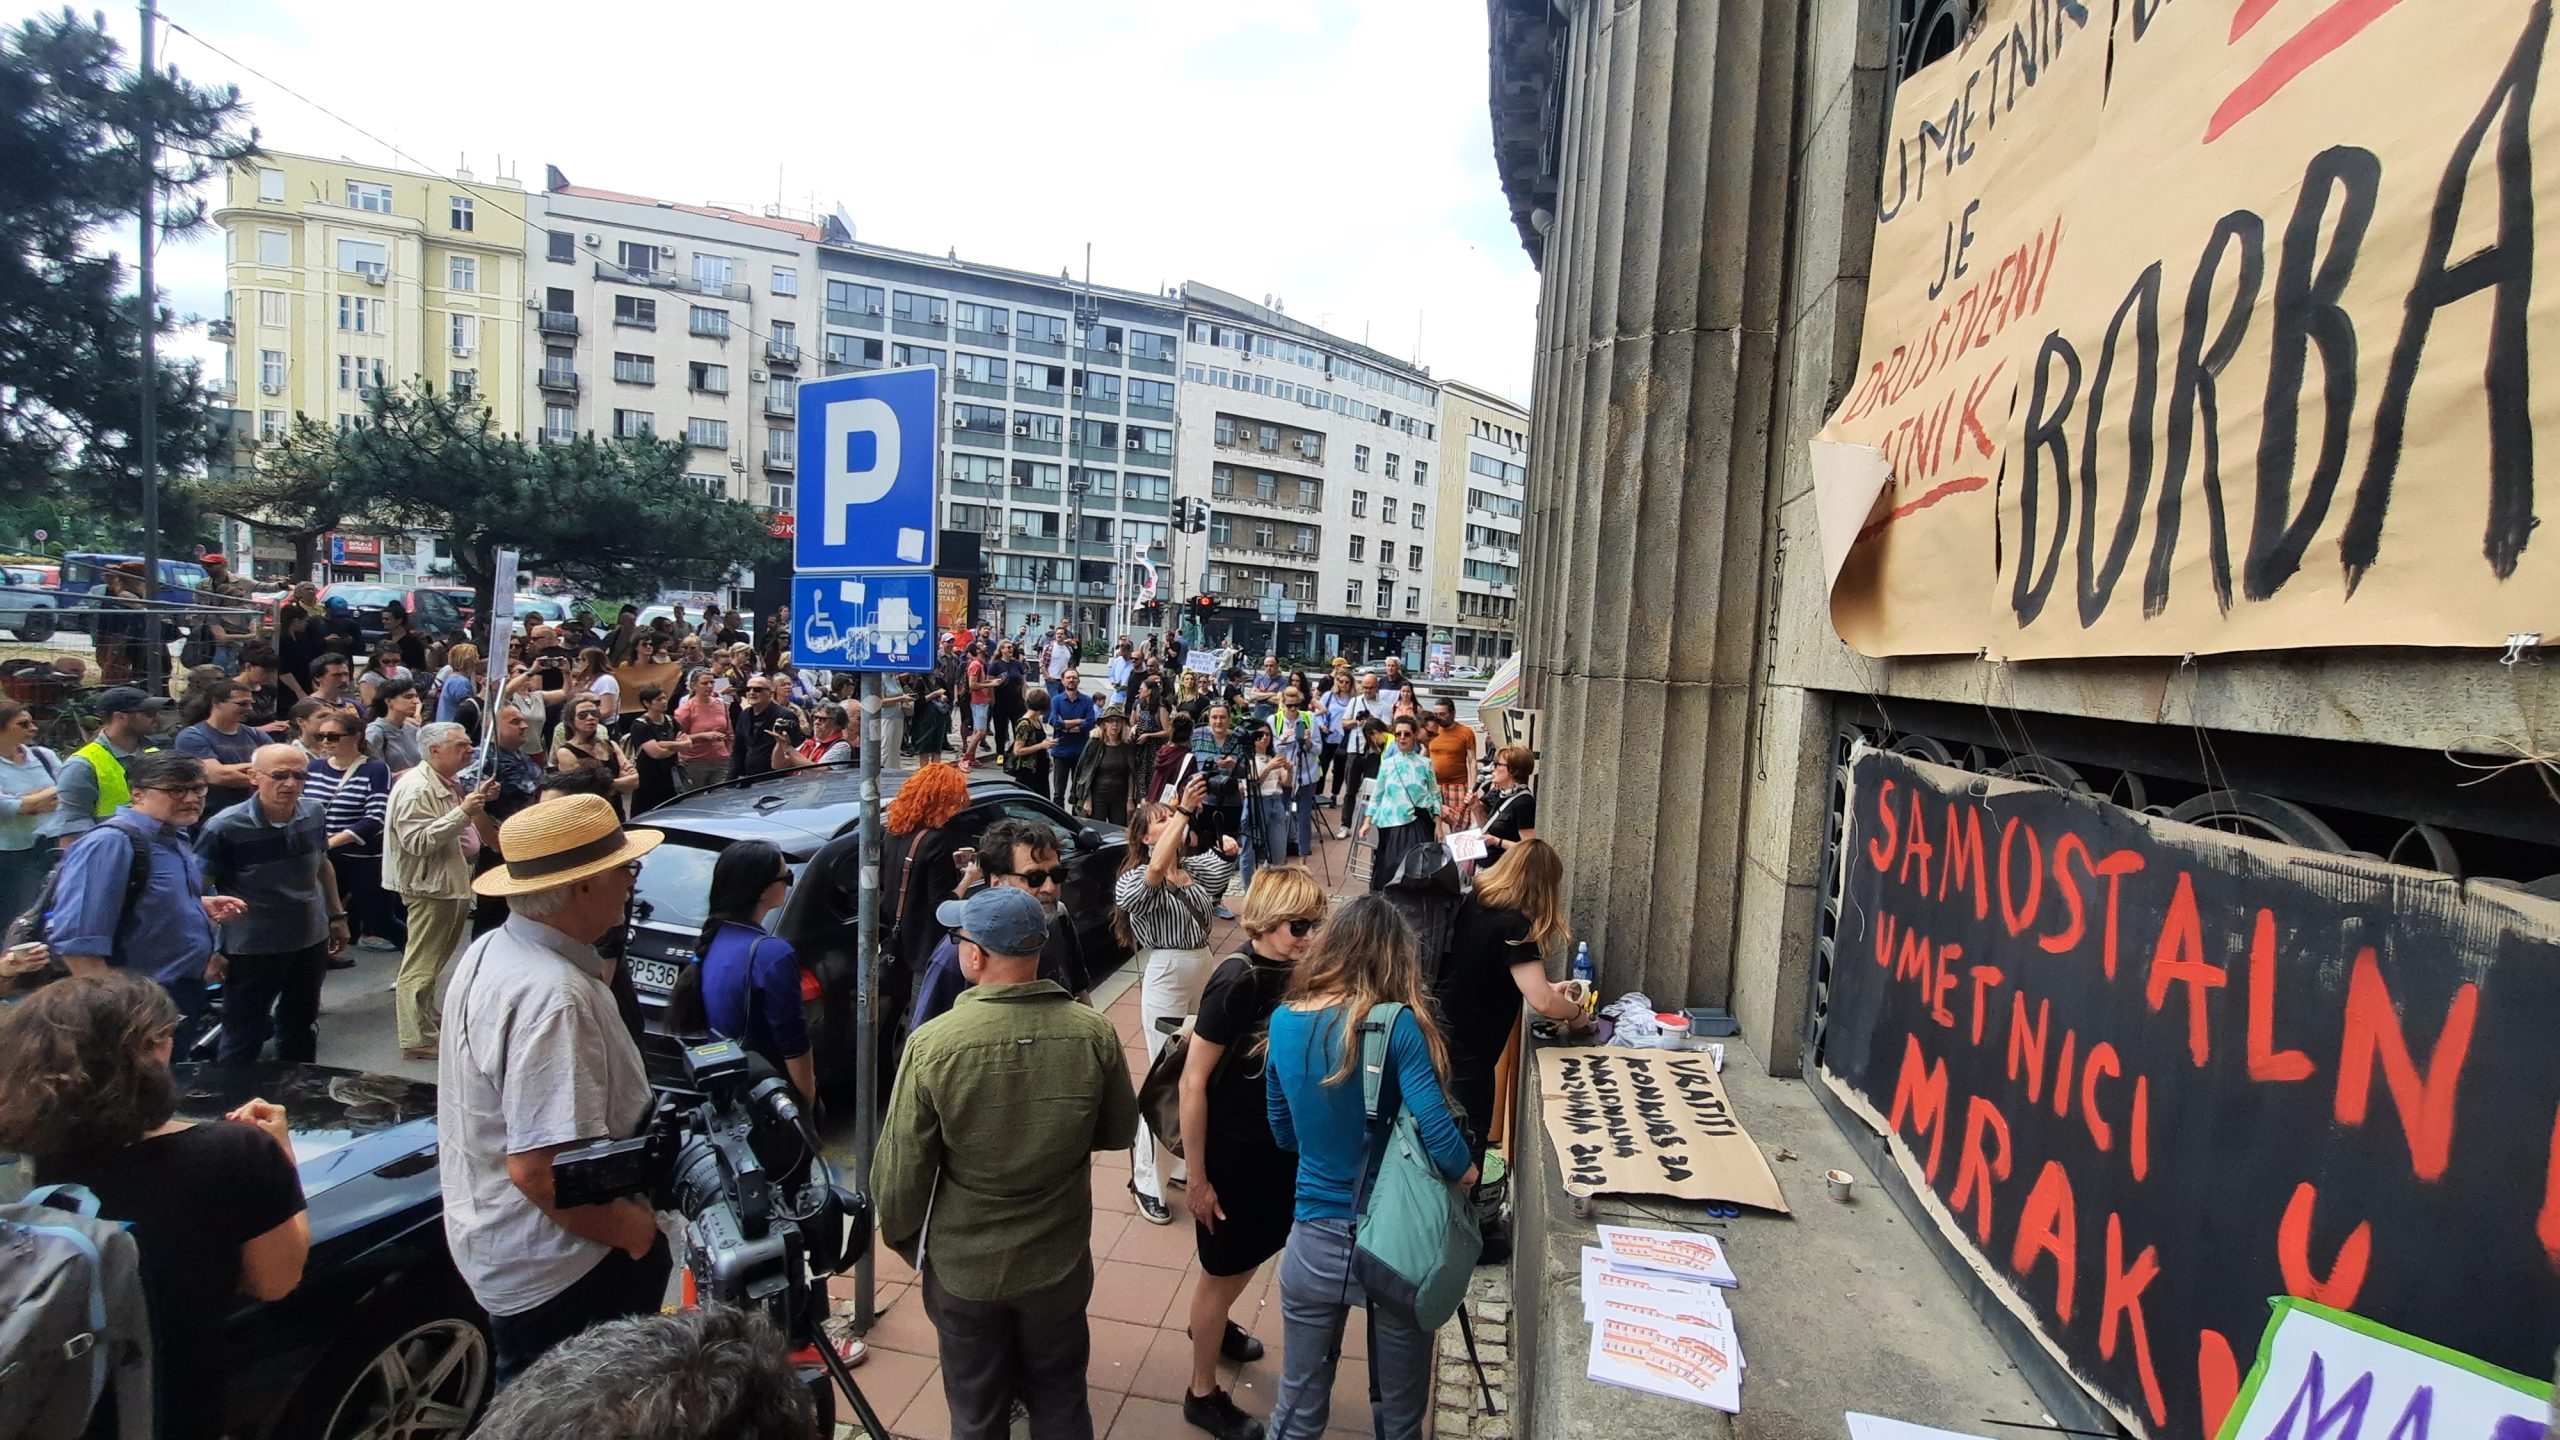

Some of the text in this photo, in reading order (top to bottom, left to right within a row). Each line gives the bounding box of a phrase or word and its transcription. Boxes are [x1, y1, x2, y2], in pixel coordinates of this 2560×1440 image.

[1929, 199, 1980, 300] JE
[2011, 0, 2552, 629] BORBA
[824, 398, 901, 546] P
[1666, 1059, 1738, 1136] VRATITI
[1869, 779, 2560, 1272] SAMOSTALN
[1875, 910, 2371, 1310] UMETNICI U
